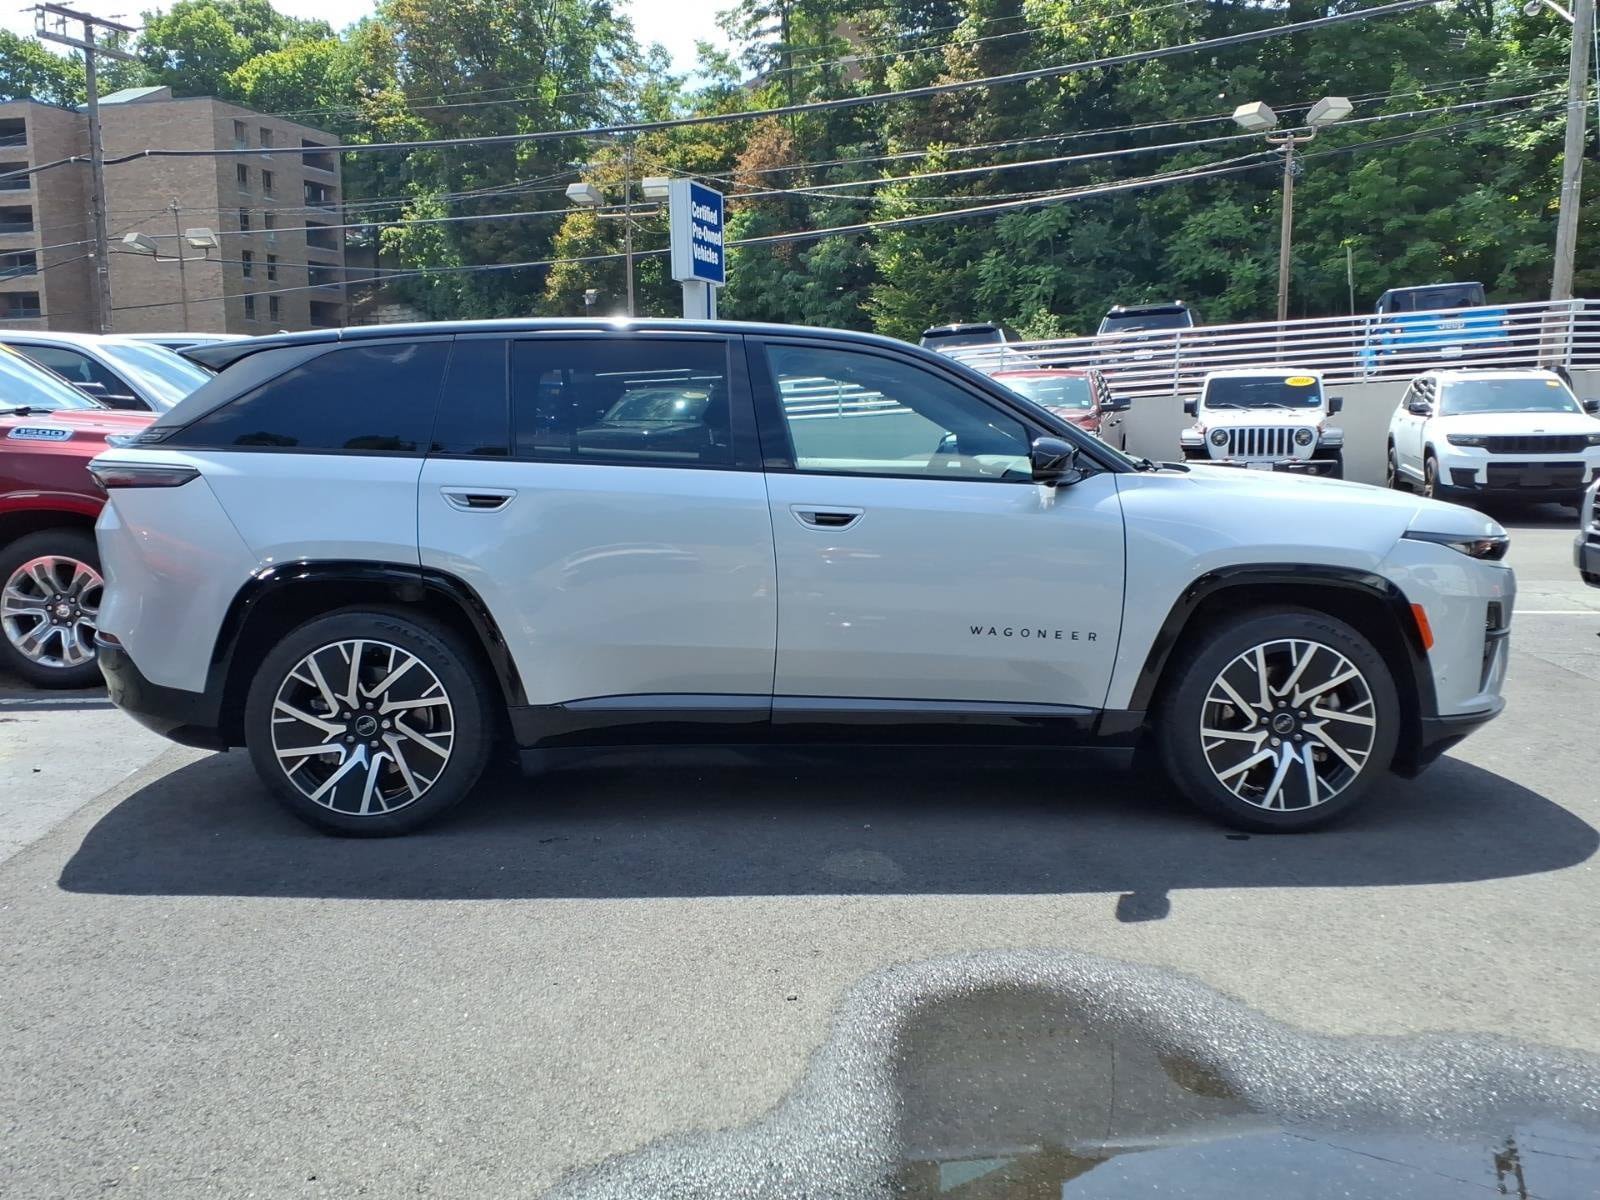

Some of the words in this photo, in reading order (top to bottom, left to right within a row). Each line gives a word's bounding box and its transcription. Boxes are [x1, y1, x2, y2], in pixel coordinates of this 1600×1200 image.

[692, 201, 717, 225] Certified
[693, 222, 722, 246] Pre-Owned
[693, 242, 719, 265] Vehicles
[19, 428, 65, 437] 1500
[970, 625, 1098, 641] WAGONEER
